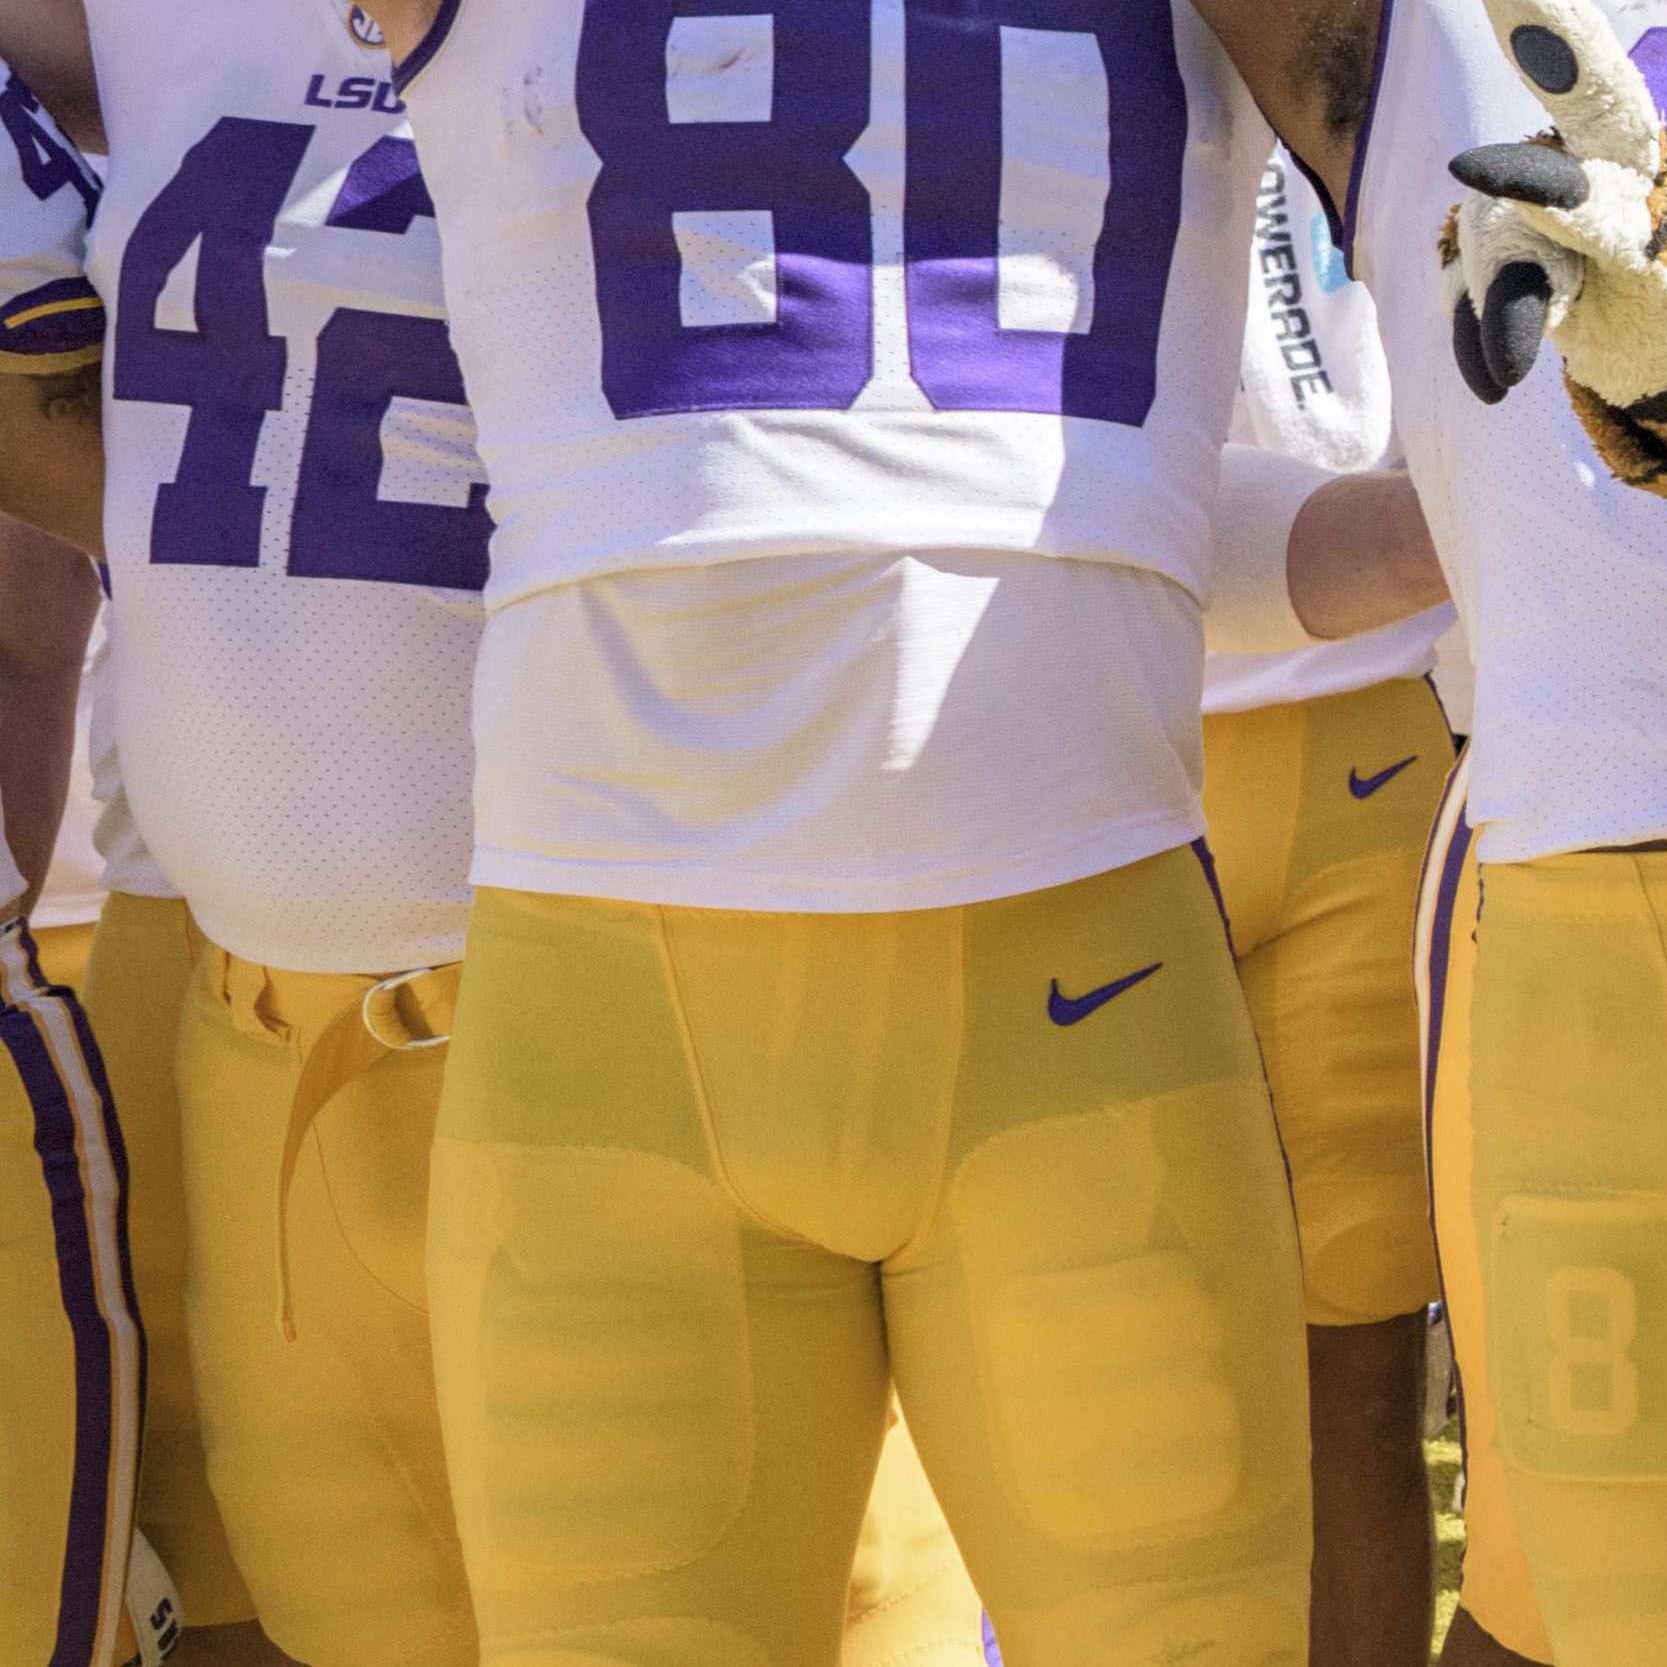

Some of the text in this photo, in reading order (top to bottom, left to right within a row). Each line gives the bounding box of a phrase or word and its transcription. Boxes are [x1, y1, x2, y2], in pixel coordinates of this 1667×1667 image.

[304, 73, 407, 115] LSU
[113, 116, 496, 591] 42
[1254, 162, 1334, 411] OWERADE
[1546, 1267, 1639, 1436] 8
